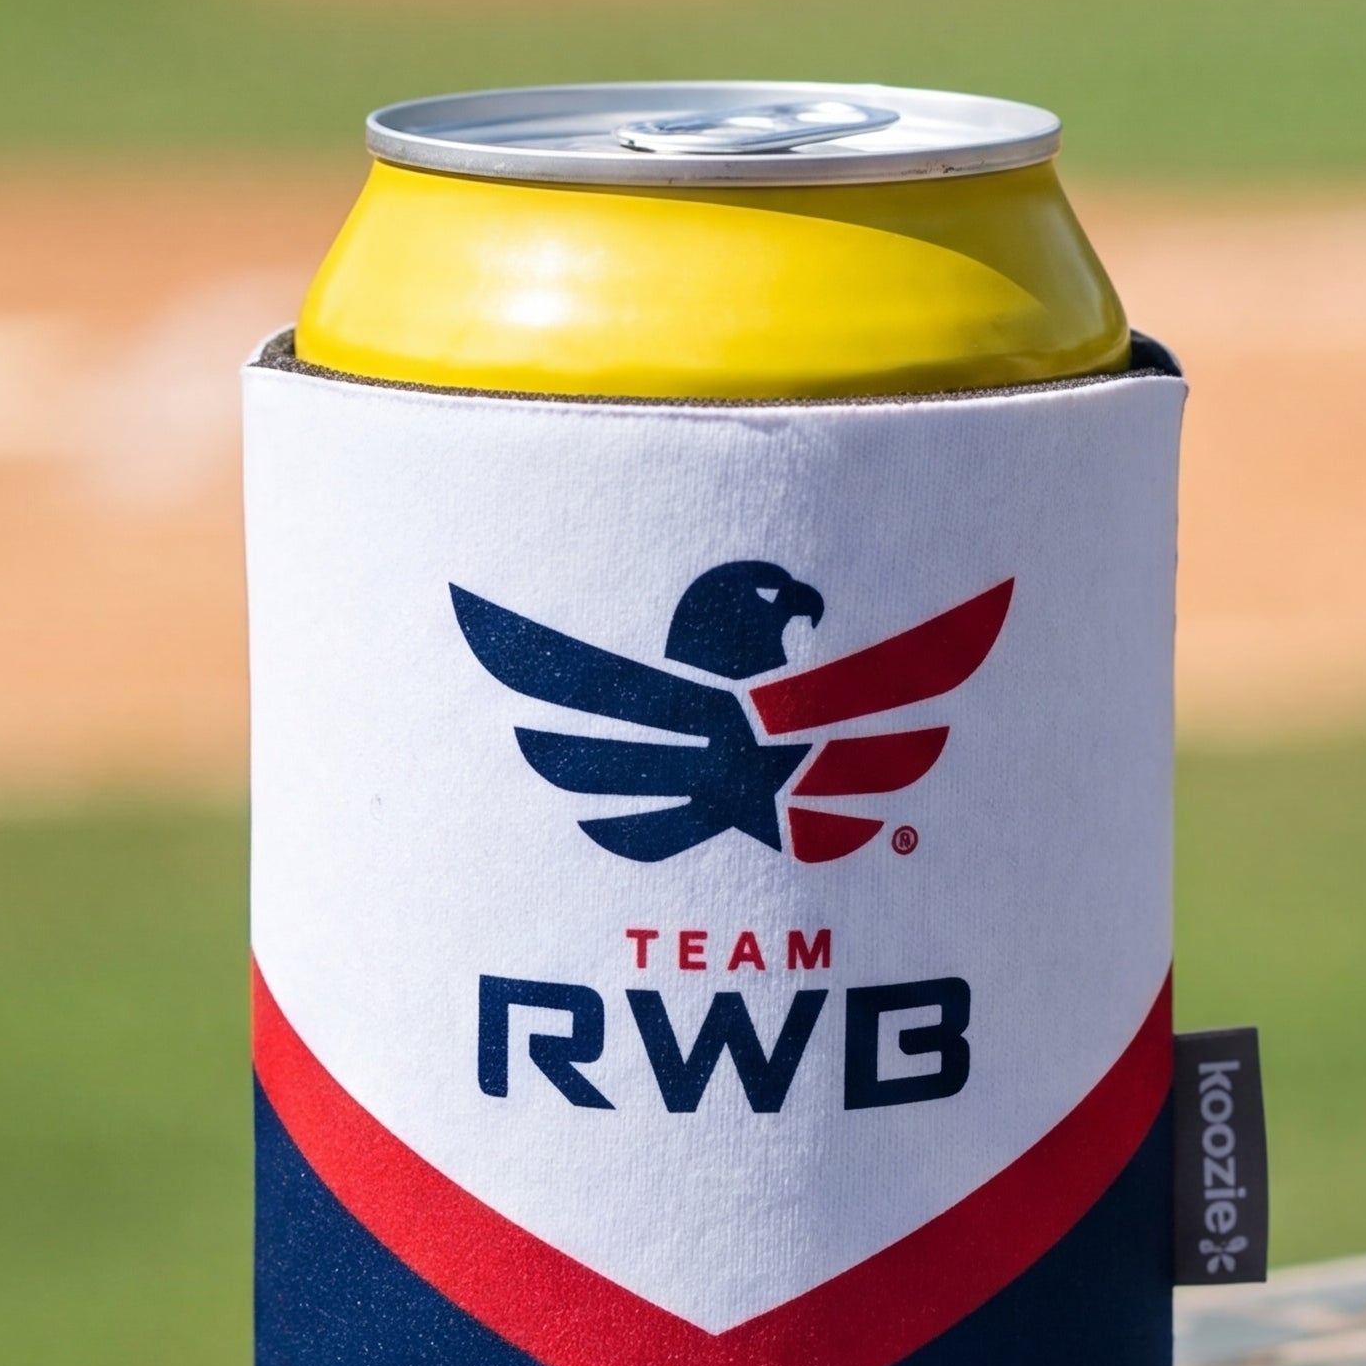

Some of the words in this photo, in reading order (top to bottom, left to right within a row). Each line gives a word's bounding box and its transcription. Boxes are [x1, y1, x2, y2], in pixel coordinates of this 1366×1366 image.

[626, 929, 832, 971] TEAM
[478, 973, 971, 1113] RWB
[1197, 1060, 1247, 1234] koozie
